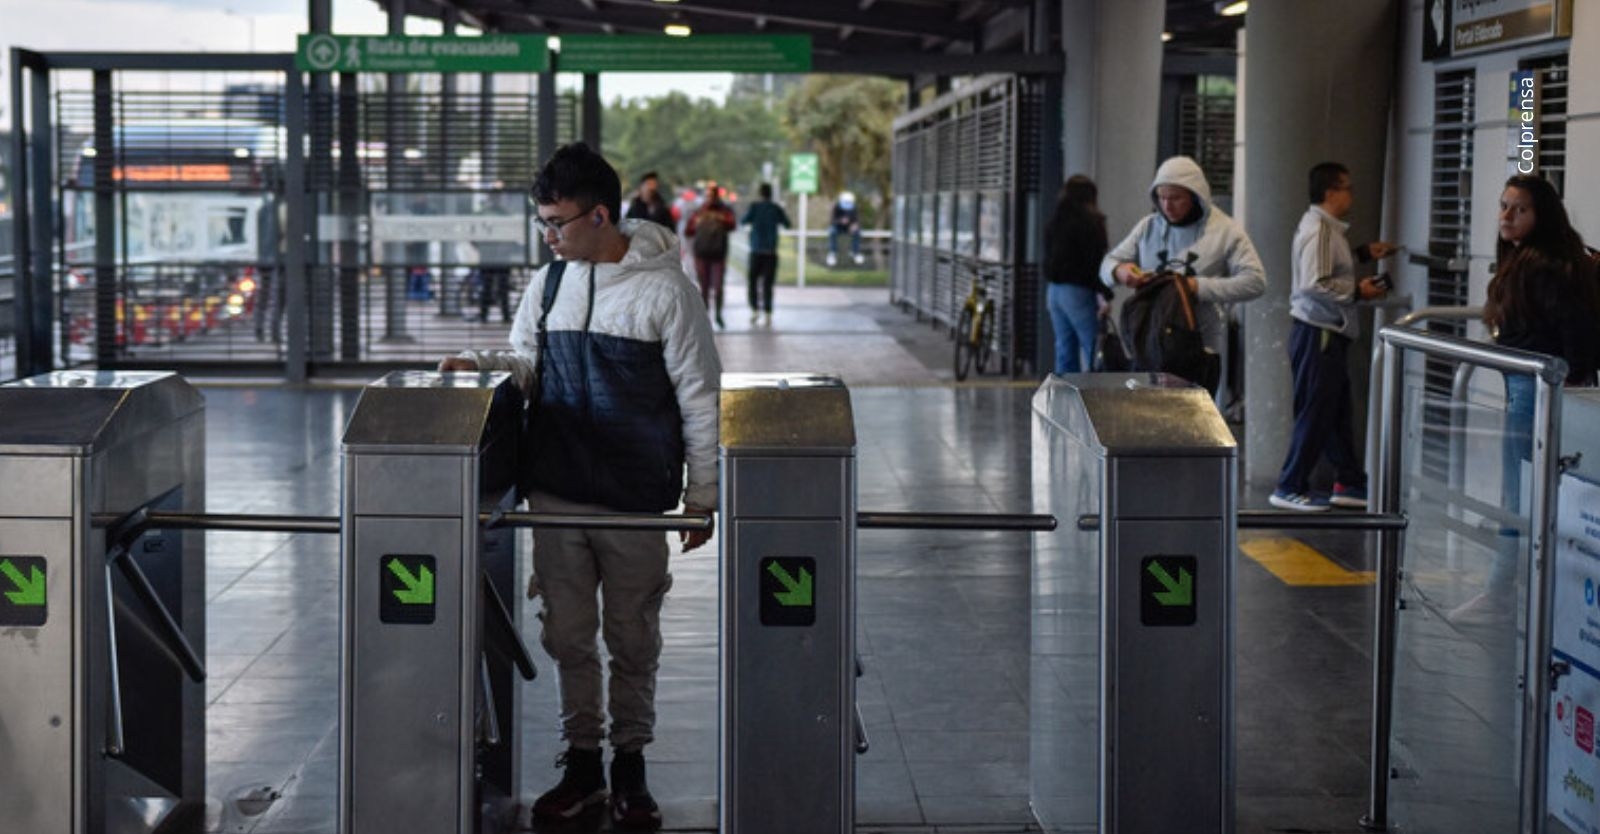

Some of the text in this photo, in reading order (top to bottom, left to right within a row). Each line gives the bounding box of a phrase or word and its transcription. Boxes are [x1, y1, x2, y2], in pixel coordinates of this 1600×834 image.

[367, 37, 520, 56] Ruta de evacuación
